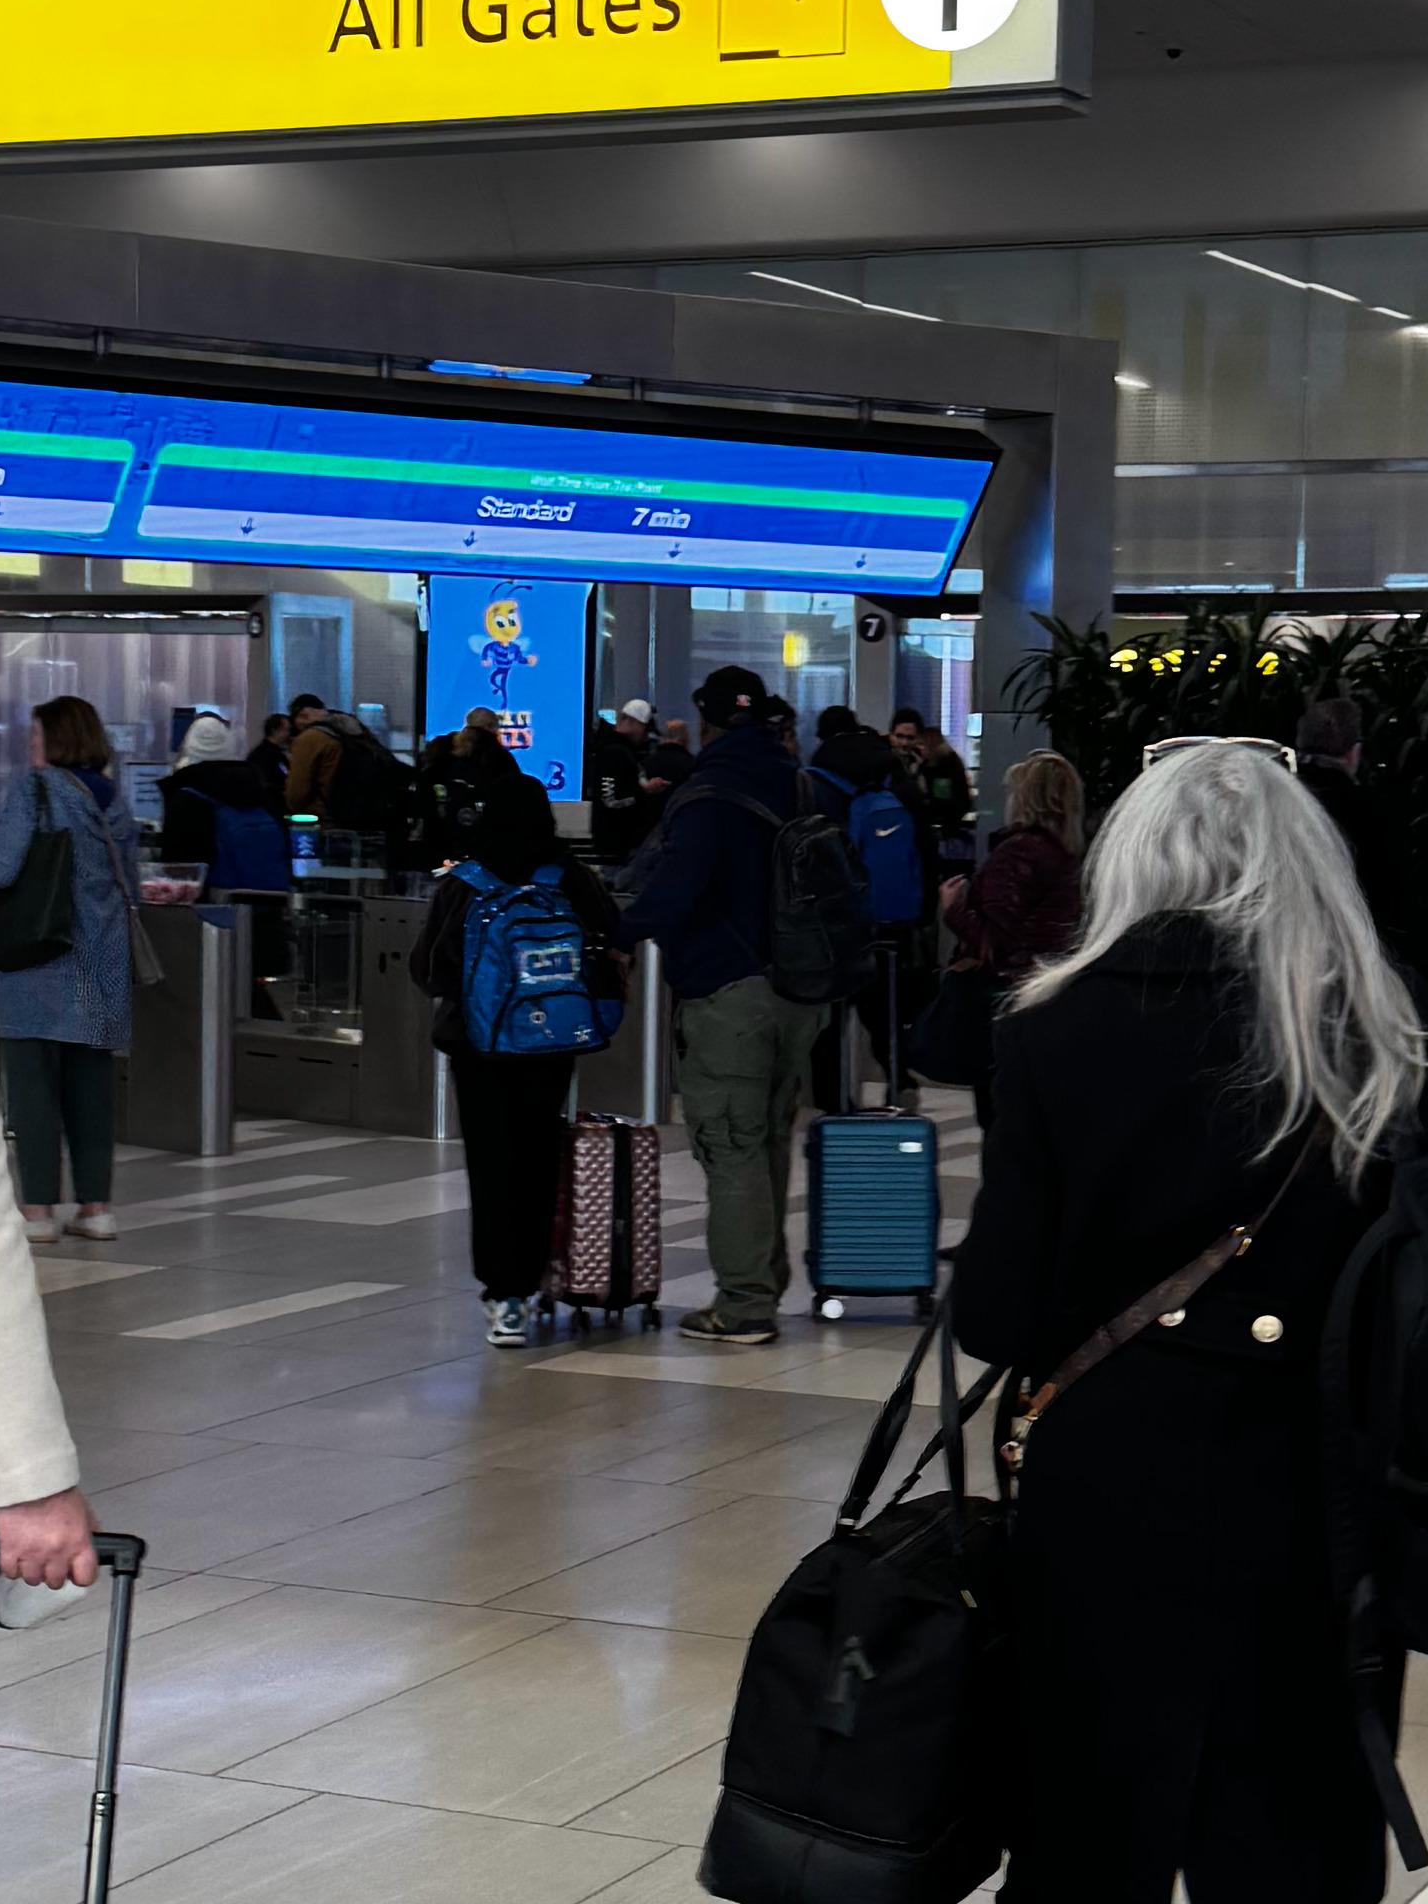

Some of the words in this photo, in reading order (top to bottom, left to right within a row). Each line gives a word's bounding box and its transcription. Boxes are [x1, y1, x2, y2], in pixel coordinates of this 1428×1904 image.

[476, 495, 577, 523] Standard
[631, 506, 650, 527] 7
[647, 508, 691, 530] min
[864, 617, 881, 638] 7
